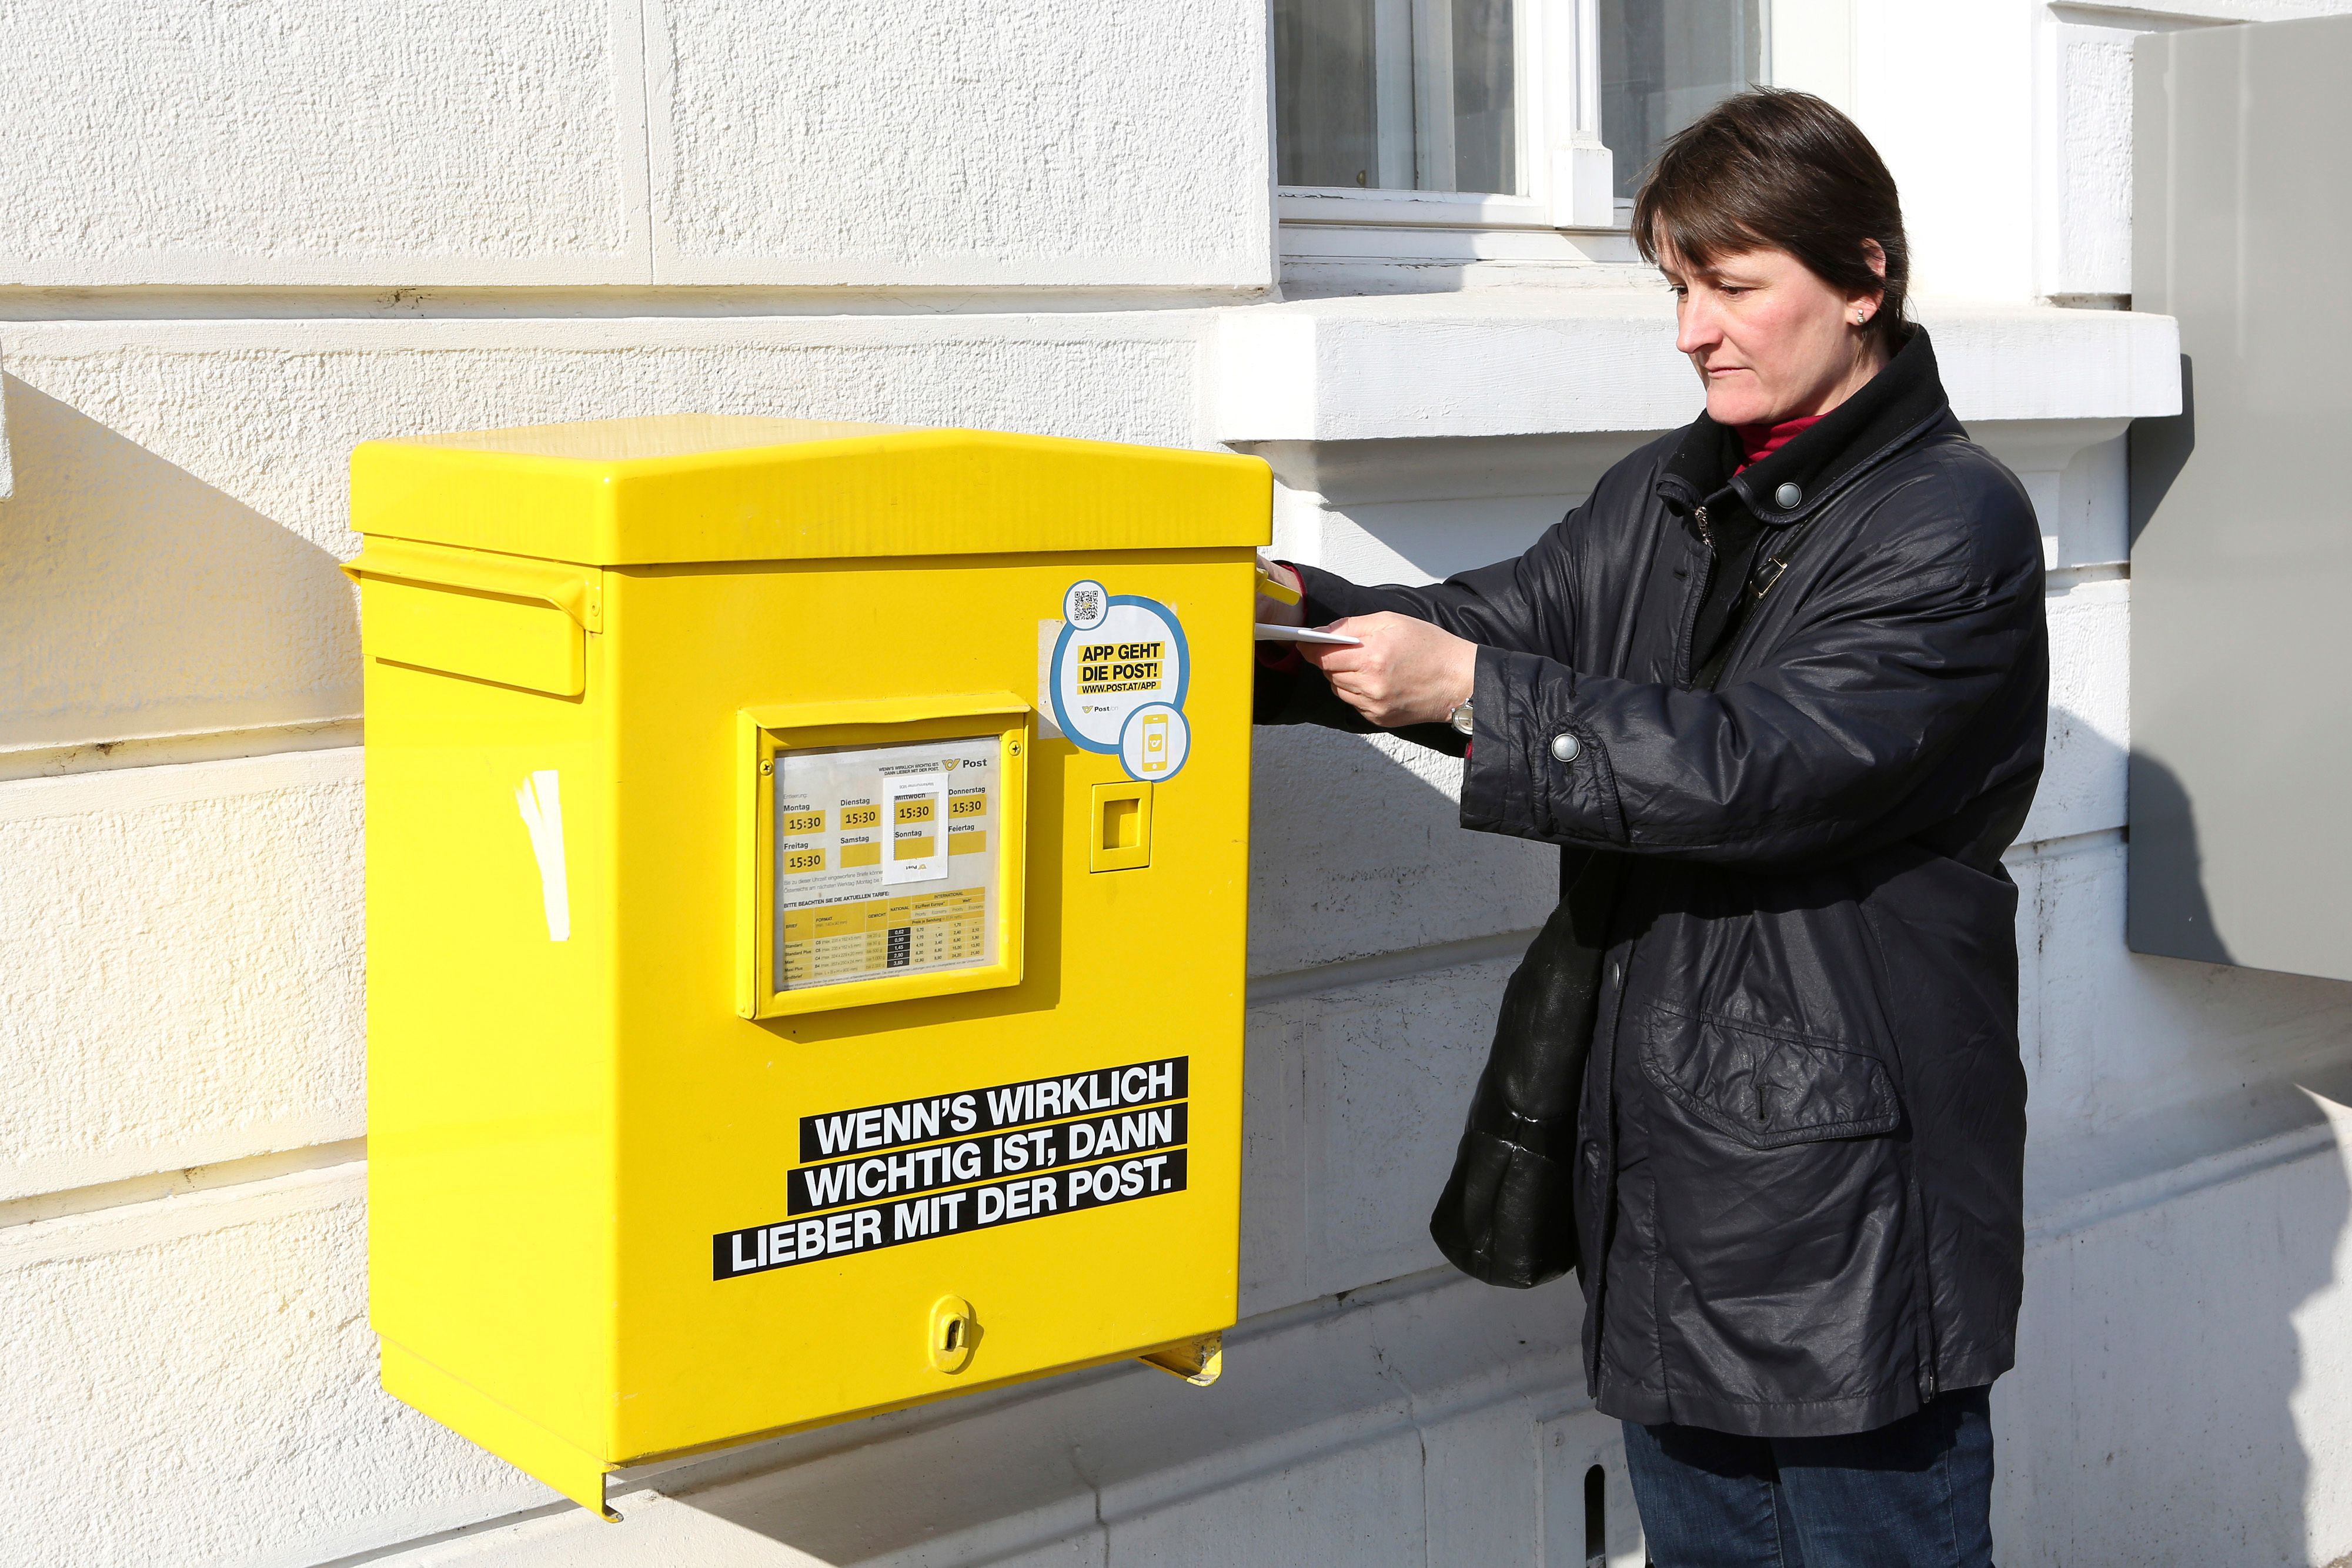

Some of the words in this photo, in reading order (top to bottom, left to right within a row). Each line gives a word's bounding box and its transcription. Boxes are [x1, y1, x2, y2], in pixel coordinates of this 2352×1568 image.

[1082, 646, 1114, 662] APP
[1118, 643, 1161, 660] GEHT
[1083, 665, 1108, 681] DIE
[1113, 663, 1158, 680] POST!
[1083, 681, 1156, 694] WWW.POST.AT/APP
[963, 759, 987, 768] Post
[790, 817, 821, 830] 15:30
[846, 811, 876, 824] 15:30
[900, 806, 929, 818] 15:30
[953, 801, 981, 813] 15:30
[790, 855, 820, 868] 15:30
[815, 1095, 977, 1155] WENN'S
[985, 1063, 1174, 1126] WIRKLICH
[804, 1143, 981, 1207] WICHTIG
[994, 1129, 1058, 1174] IST,
[1068, 1109, 1172, 1158] DANN
[731, 1209, 882, 1272] LIEBER
[894, 1193, 965, 1241] MIT
[977, 1178, 1058, 1223] DER
[1068, 1155, 1171, 1208] POST.
